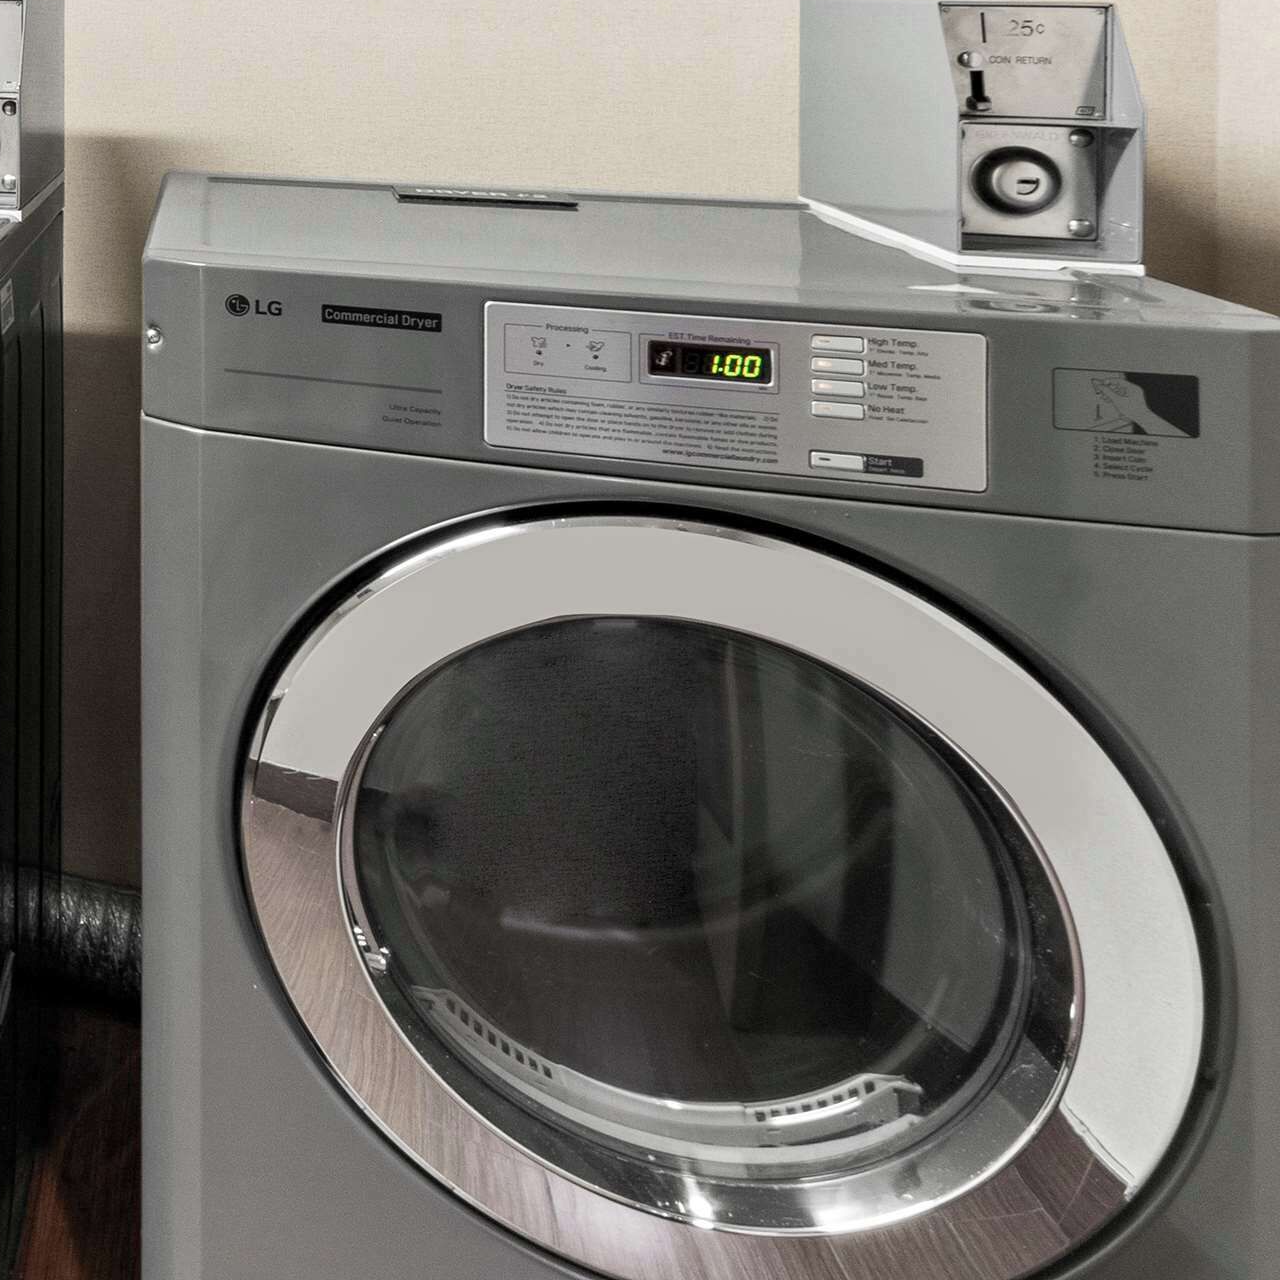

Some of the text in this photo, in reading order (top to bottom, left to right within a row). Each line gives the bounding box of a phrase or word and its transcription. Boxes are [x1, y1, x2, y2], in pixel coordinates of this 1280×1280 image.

[988, 55, 1053, 65] COIN RETURN
[255, 299, 283, 316] LG
[324, 308, 439, 329] Commercial Dryer
[545, 323, 589, 334] Processing
[708, 334, 752, 346] Remaining
[867, 337, 889, 347] High
[711, 354, 762, 378] 1.00
[868, 360, 889, 369] Med
[867, 381, 888, 390] Low
[409, 406, 441, 416] Capacity
[882, 406, 905, 415] Heat
[404, 417, 442, 427] Operation
